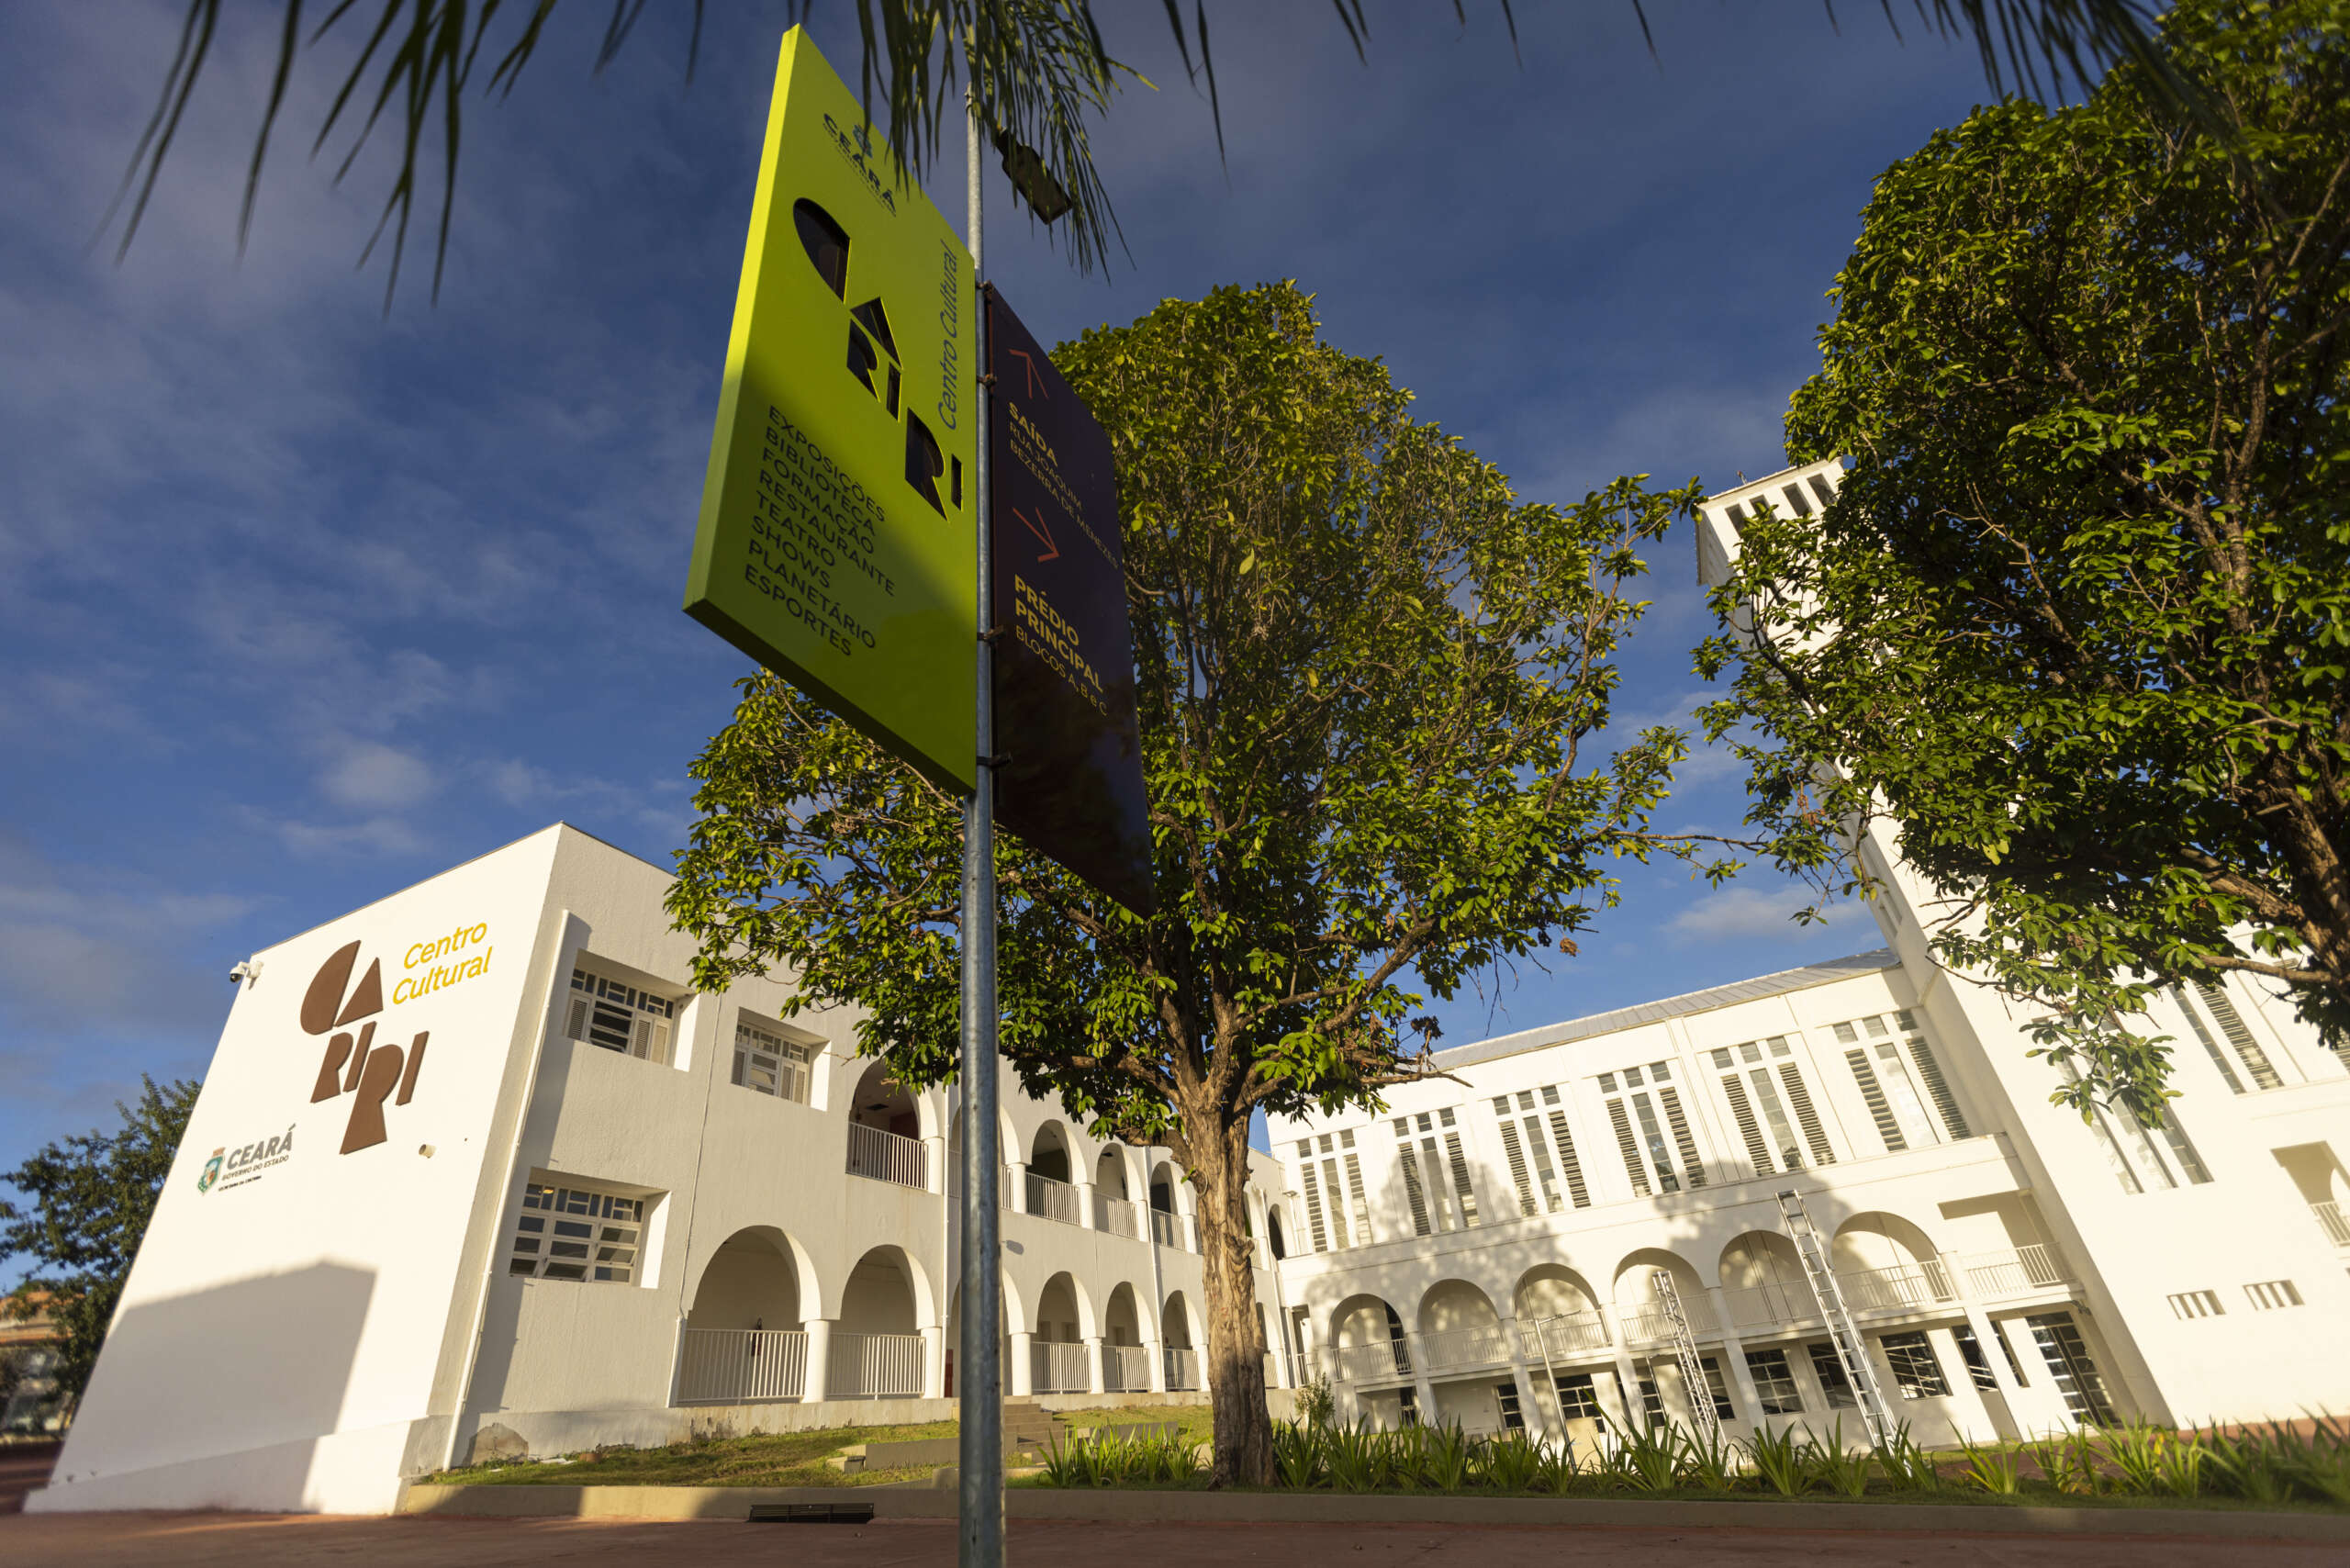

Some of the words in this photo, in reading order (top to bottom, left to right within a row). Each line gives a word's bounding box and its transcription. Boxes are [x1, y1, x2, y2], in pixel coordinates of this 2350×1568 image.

[823, 113, 897, 212] CEARÁ
[939, 239, 957, 339] Cultural
[938, 339, 957, 431] Centro
[769, 405, 886, 522] EXPOSIÇÕES
[1009, 401, 1058, 468] SAÍDA
[1010, 421, 1034, 455] RUA
[1010, 439, 1060, 502] BEZERRA
[763, 447, 874, 554] FORMAÇÃO
[766, 426, 876, 536] BIBLIOTECA
[751, 515, 831, 588] SHOWS
[756, 489, 835, 566] TEATRO
[760, 470, 895, 597] RESTAURANTE
[744, 564, 852, 656] ESPORTES
[748, 538, 876, 648] PLANETÁRIO
[1014, 574, 1080, 646] PRÉDIO
[1015, 598, 1103, 694] PRINCIPAL
[1015, 624, 1067, 678] BLOCOS
[392, 946, 493, 1005] Cultural
[404, 922, 487, 969] Centro
[227, 1122, 297, 1170] CEARÁ
[263, 1154, 290, 1169] ESTADO
